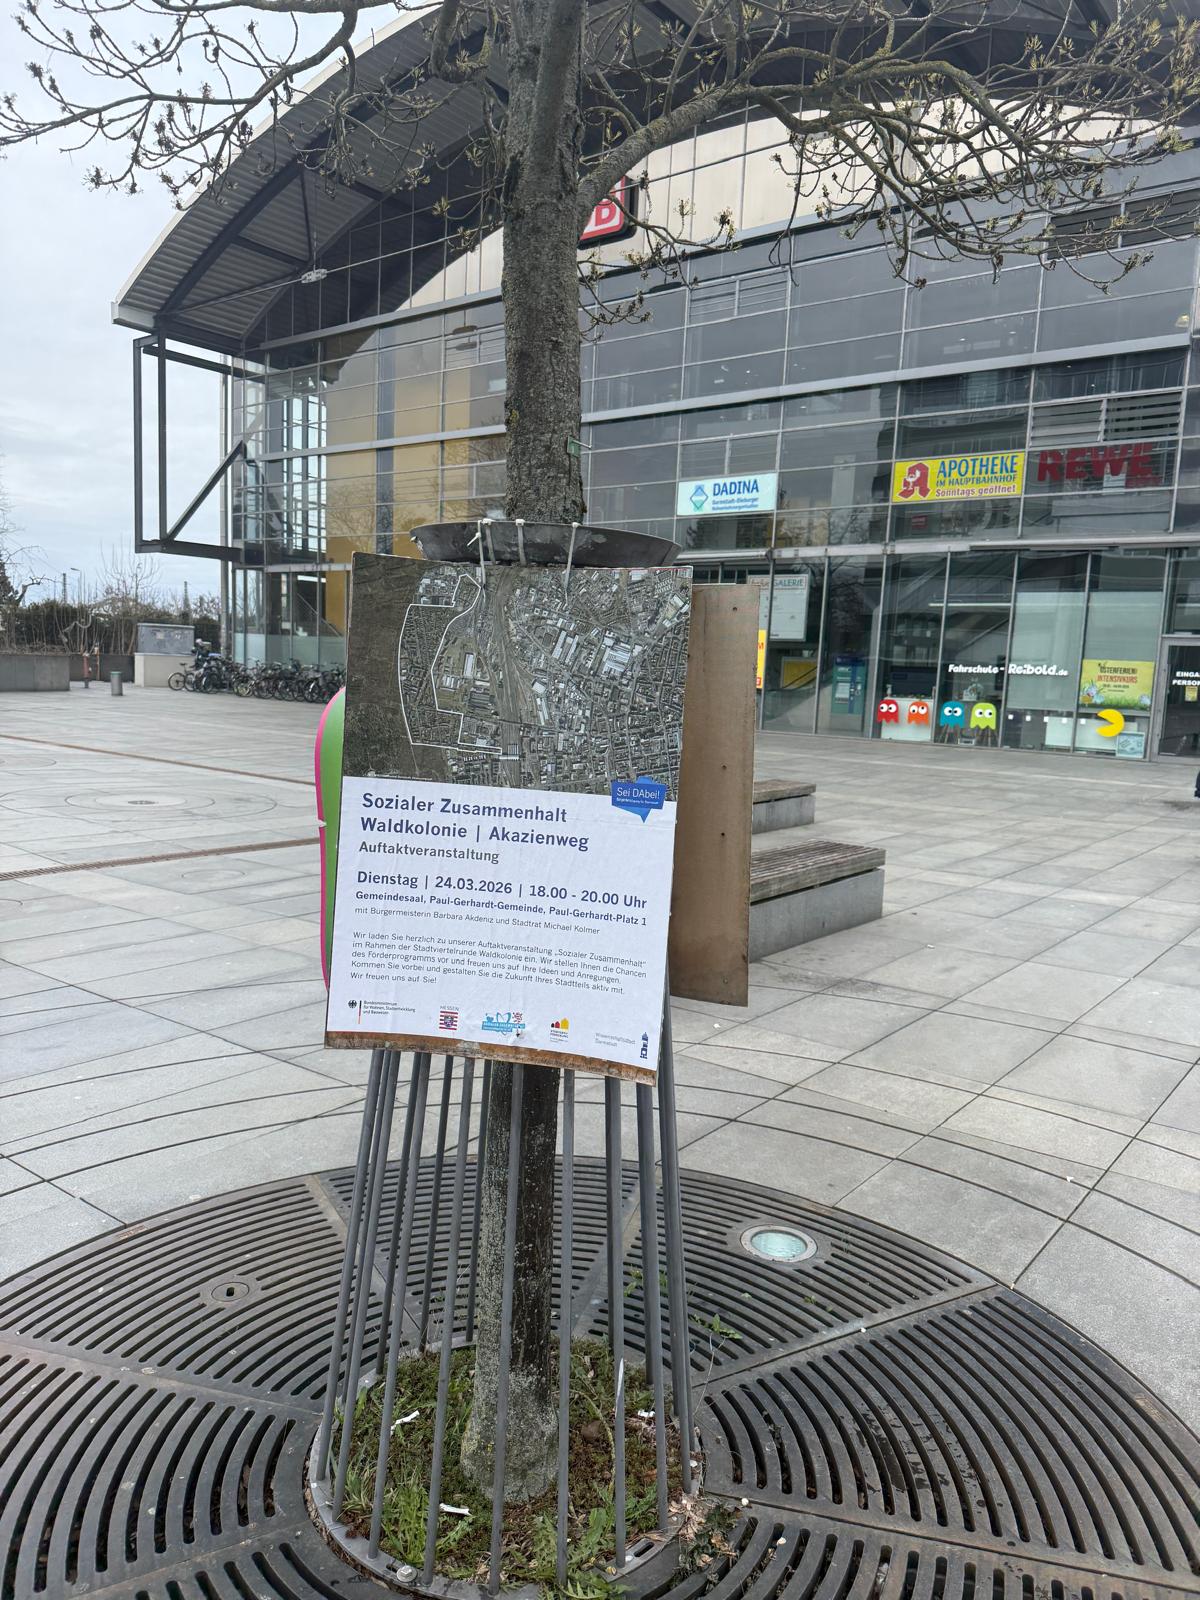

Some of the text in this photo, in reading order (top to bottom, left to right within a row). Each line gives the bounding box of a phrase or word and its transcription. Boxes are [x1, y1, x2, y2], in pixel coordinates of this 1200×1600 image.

[937, 455, 1019, 478] APOTHEKE
[1038, 443, 1152, 481] REWE
[713, 479, 759, 496] DADINA
[936, 485, 1016, 497] Sonntags geöffnet
[948, 474, 1016, 486] HAUPTBAHNHOF
[948, 664, 999, 673] Fahrschule
[1008, 664, 1068, 676] Reibold.de
[617, 787, 660, 799] Sei DAbei!
[361, 792, 568, 823] Sozialer Zusammenhalt
[360, 816, 468, 838] Waldkolonie
[488, 823, 590, 852] Akazienweg
[358, 840, 500, 865] Auftaktveranstaltung
[357, 870, 419, 889] Dienstag
[434, 875, 513, 897] 24.03.2026
[528, 884, 568, 900] 18.00
[580, 889, 619, 906] 20.00
[623, 894, 648, 909] Uhr
[354, 906, 368, 914] mit
[432, 910, 464, 921] Barbara
[464, 912, 494, 924] Akdeniz
[495, 917, 510, 925] und
[511, 917, 542, 928] Stadtrat
[543, 921, 572, 932] Michael
[573, 924, 600, 935] Kolmer
[355, 890, 647, 927] Gemeindesaal, Paul-Gerhardt-Gemeinde, Paul-Gerhardt-Platz 1
[352, 931, 367, 939] Wir
[368, 931, 390, 940] laden
[391, 932, 404, 942] Sie
[405, 934, 436, 944] herzlich
[447, 938, 476, 947] unserer
[477, 939, 553, 957] Auftaktveranstaltung
[351, 950, 366, 958] des
[437, 956, 449, 964] vor
[450, 957, 466, 966] und
[466, 957, 492, 968] freuen
[491, 962, 506, 970] uns
[506, 963, 520, 971] auf
[521, 964, 537, 973] Ihre
[538, 966, 559, 976] Ideen
[560, 969, 575, 978] und
[352, 940, 363, 949] im
[364, 940, 397, 952] Rahmen
[396, 942, 412, 951] der
[478, 949, 523, 962] Waldkolonie
[539, 955, 553, 965] Wir
[553, 958, 578, 968] stellen
[580, 961, 601, 973] Ihnen
[602, 965, 614, 973] die
[615, 966, 647, 978] Chancen
[350, 971, 364, 979] Wir
[365, 972, 390, 981] freuen
[422, 975, 437, 984] Sie!
[351, 960, 386, 969] Kommen
[387, 961, 400, 970] Sie
[400, 963, 425, 972] vorbei
[426, 965, 441, 973] und
[442, 967, 477, 976] gestalten
[477, 969, 490, 978] Sie
[490, 970, 504, 979] die
[504, 971, 533, 982] Zukunft
[534, 975, 554, 985] Ihres
[554, 977, 590, 989] Stadtteils
[591, 983, 610, 992] aktiv
